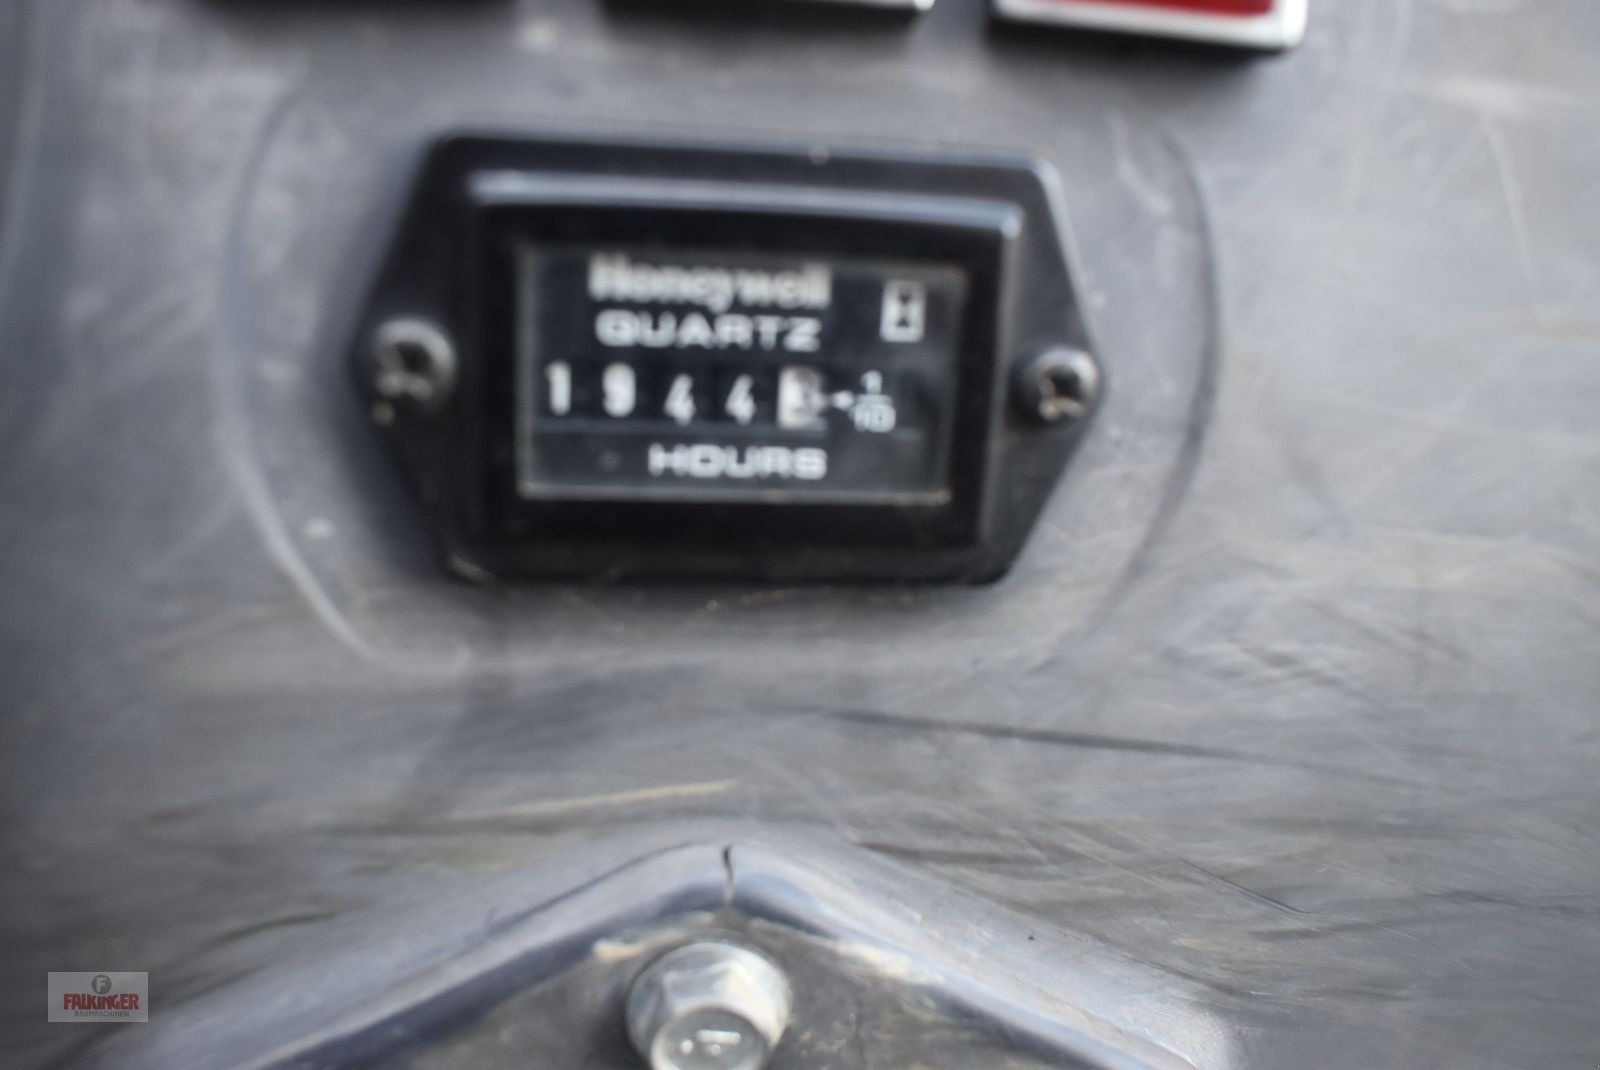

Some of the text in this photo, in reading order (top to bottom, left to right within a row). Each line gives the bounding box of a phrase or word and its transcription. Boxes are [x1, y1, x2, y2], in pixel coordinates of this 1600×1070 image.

[589, 255, 831, 312] Honeywell
[595, 311, 821, 351] QUARTZ
[648, 442, 828, 479] HOURS
